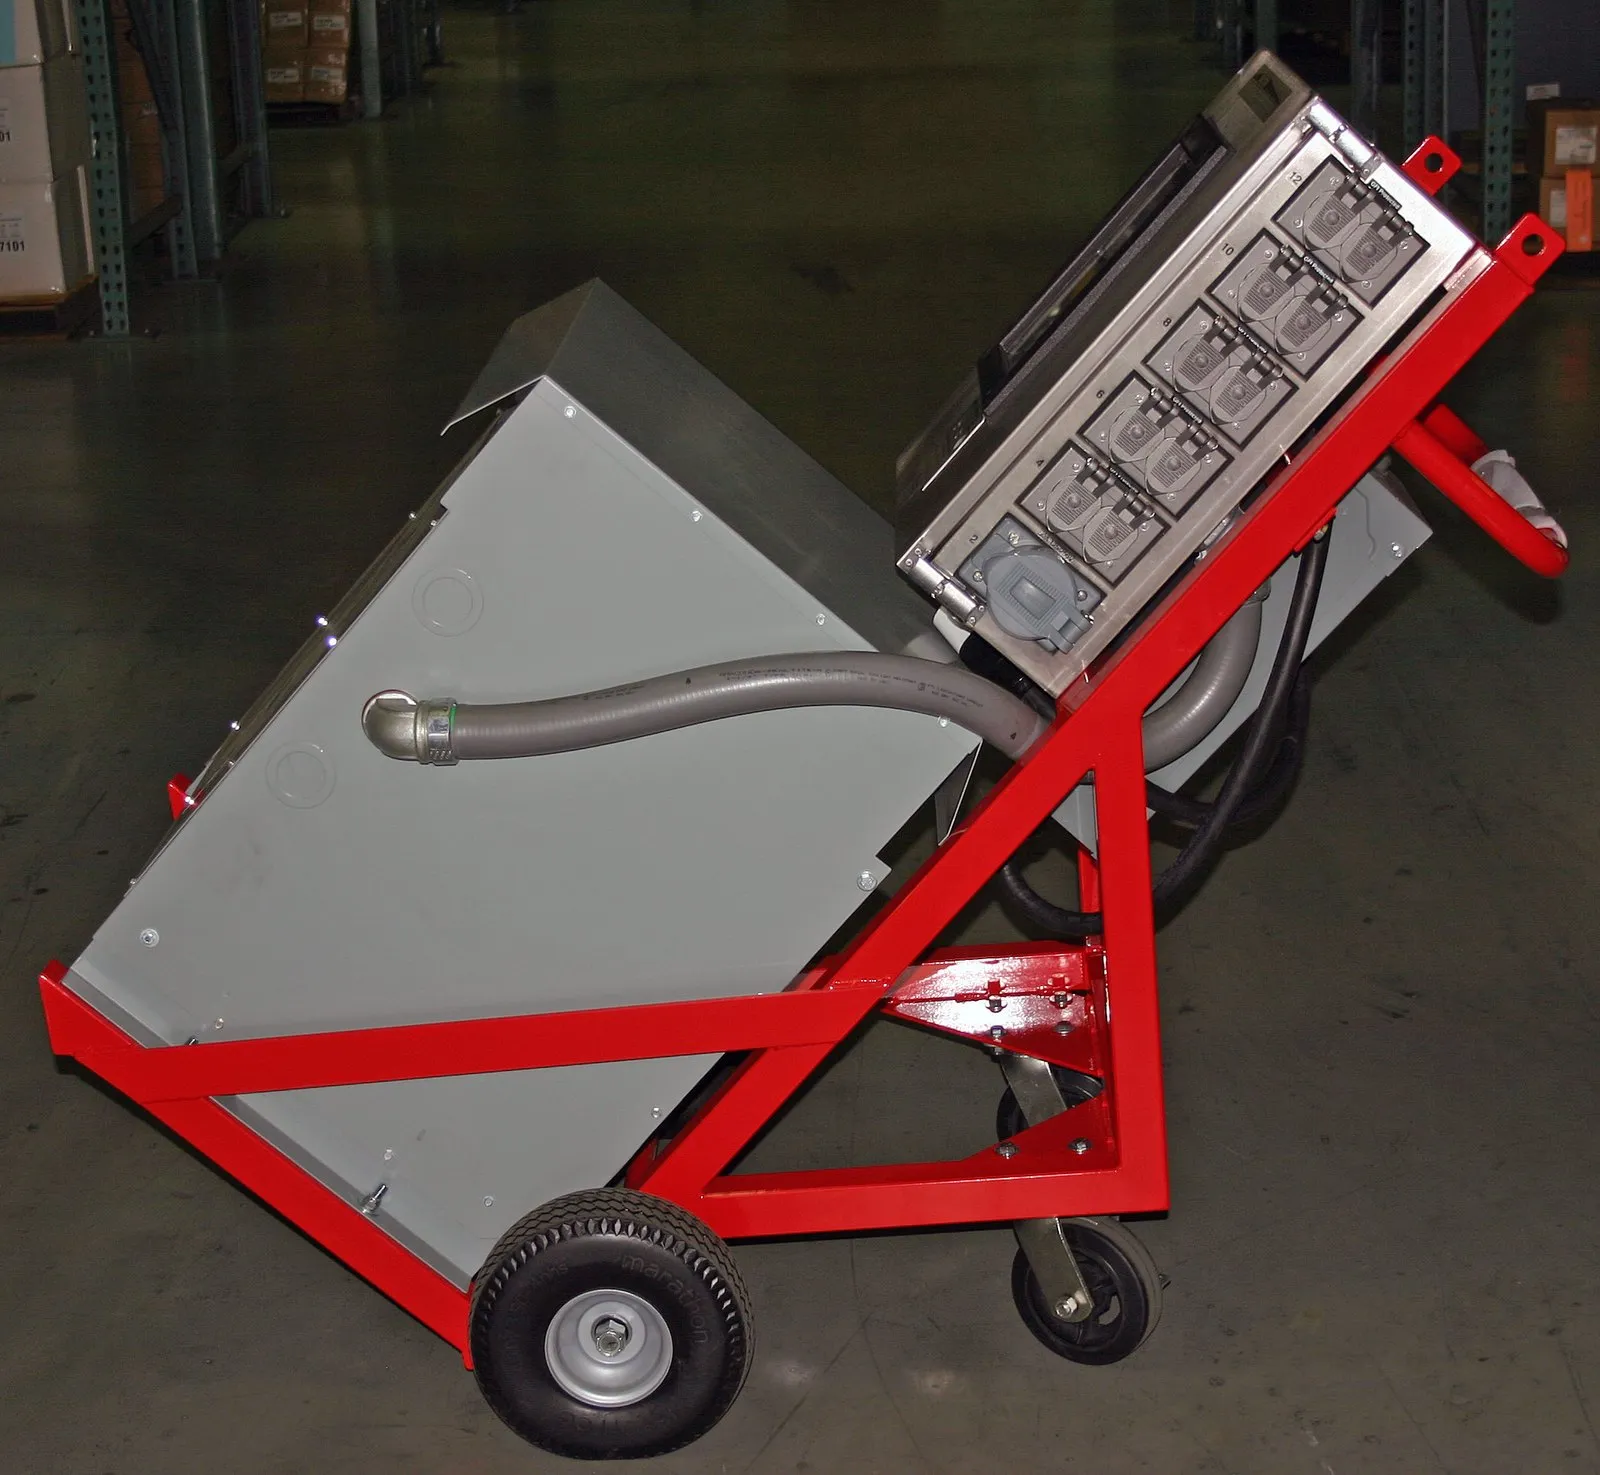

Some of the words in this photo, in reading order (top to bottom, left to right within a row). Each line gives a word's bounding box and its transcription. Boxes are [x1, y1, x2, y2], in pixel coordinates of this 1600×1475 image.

[1289, 171, 1303, 186] 12
[1379, 188, 1401, 210] Protected
[0, 240, 25, 252] 7101
[1221, 243, 1235, 256] 10
[1163, 317, 1172, 327] 8
[1096, 389, 1105, 399] 6
[969, 534, 979, 544] 2
[620, 1252, 712, 1345] marathon
